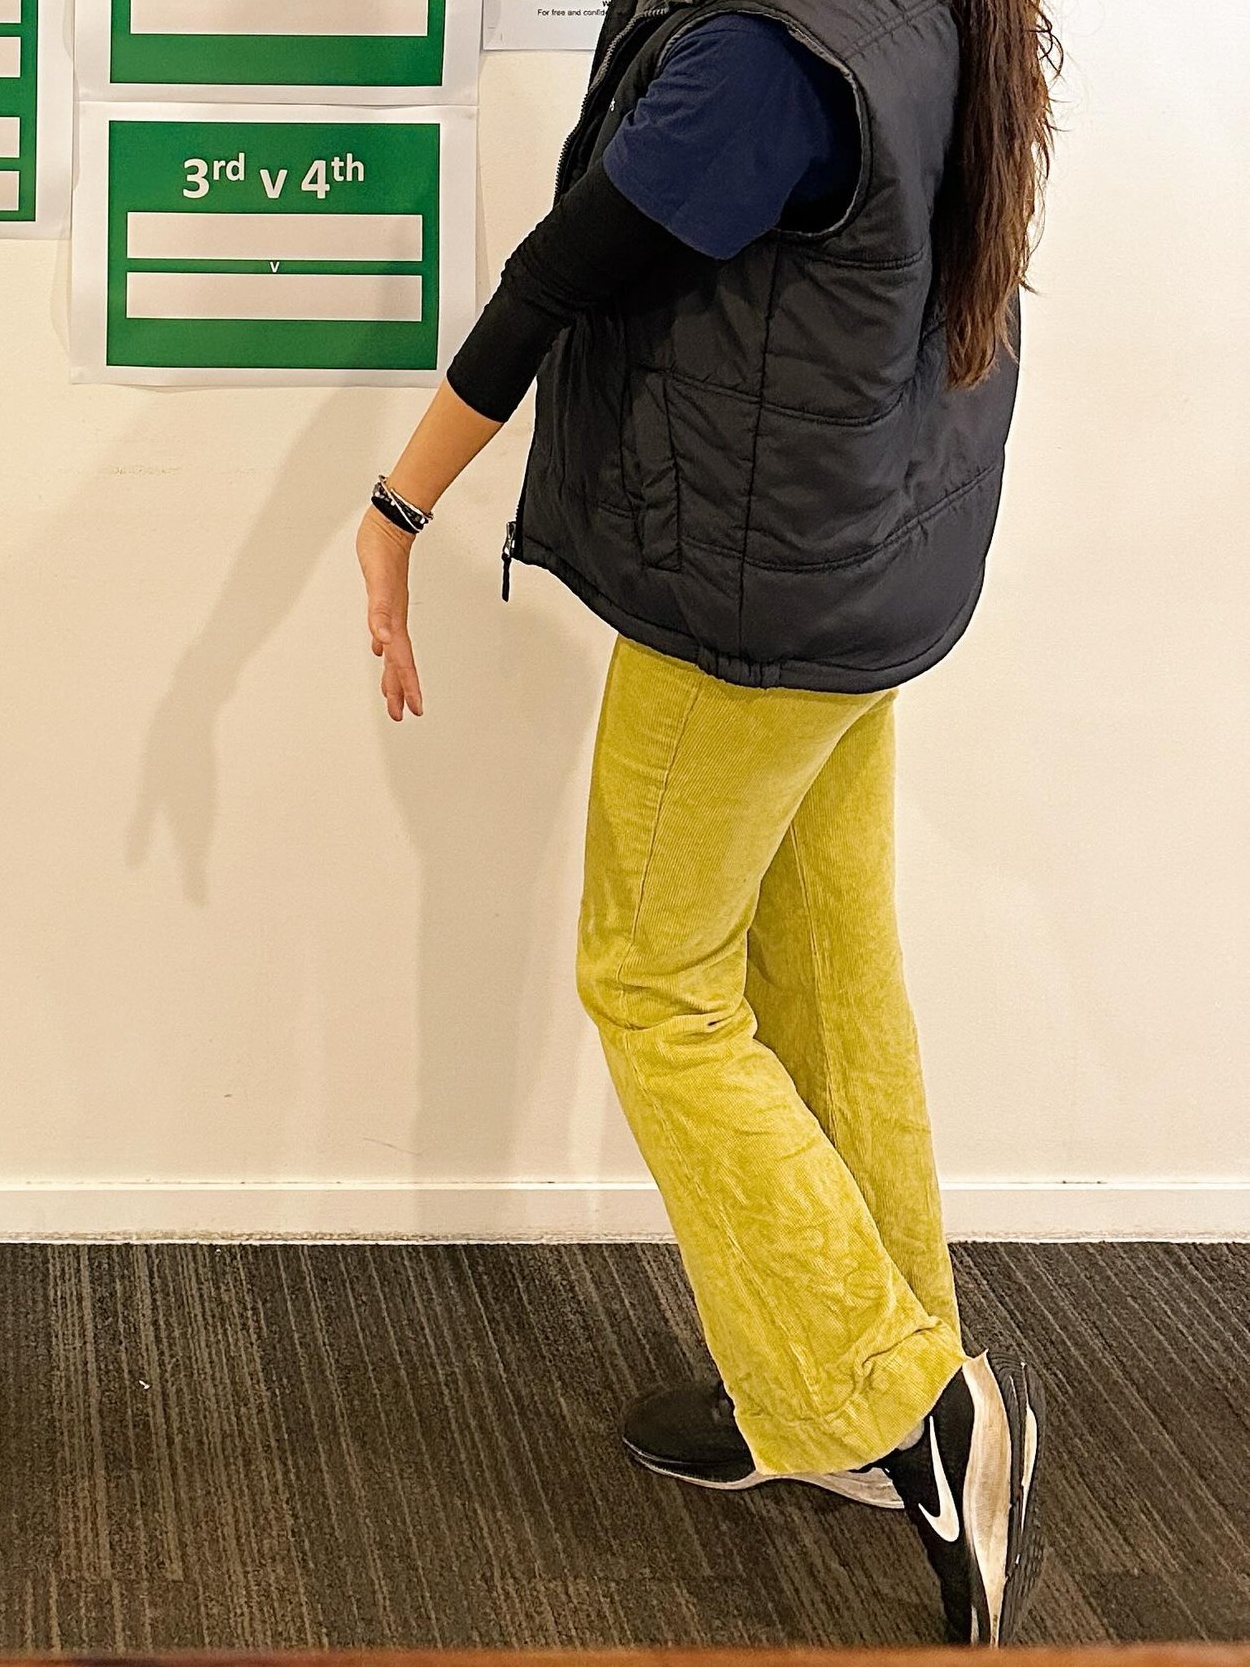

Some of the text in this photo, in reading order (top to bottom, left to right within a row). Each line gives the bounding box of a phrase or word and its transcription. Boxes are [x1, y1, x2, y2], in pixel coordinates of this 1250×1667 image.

[182, 152, 364, 199] 3rd v 4th
